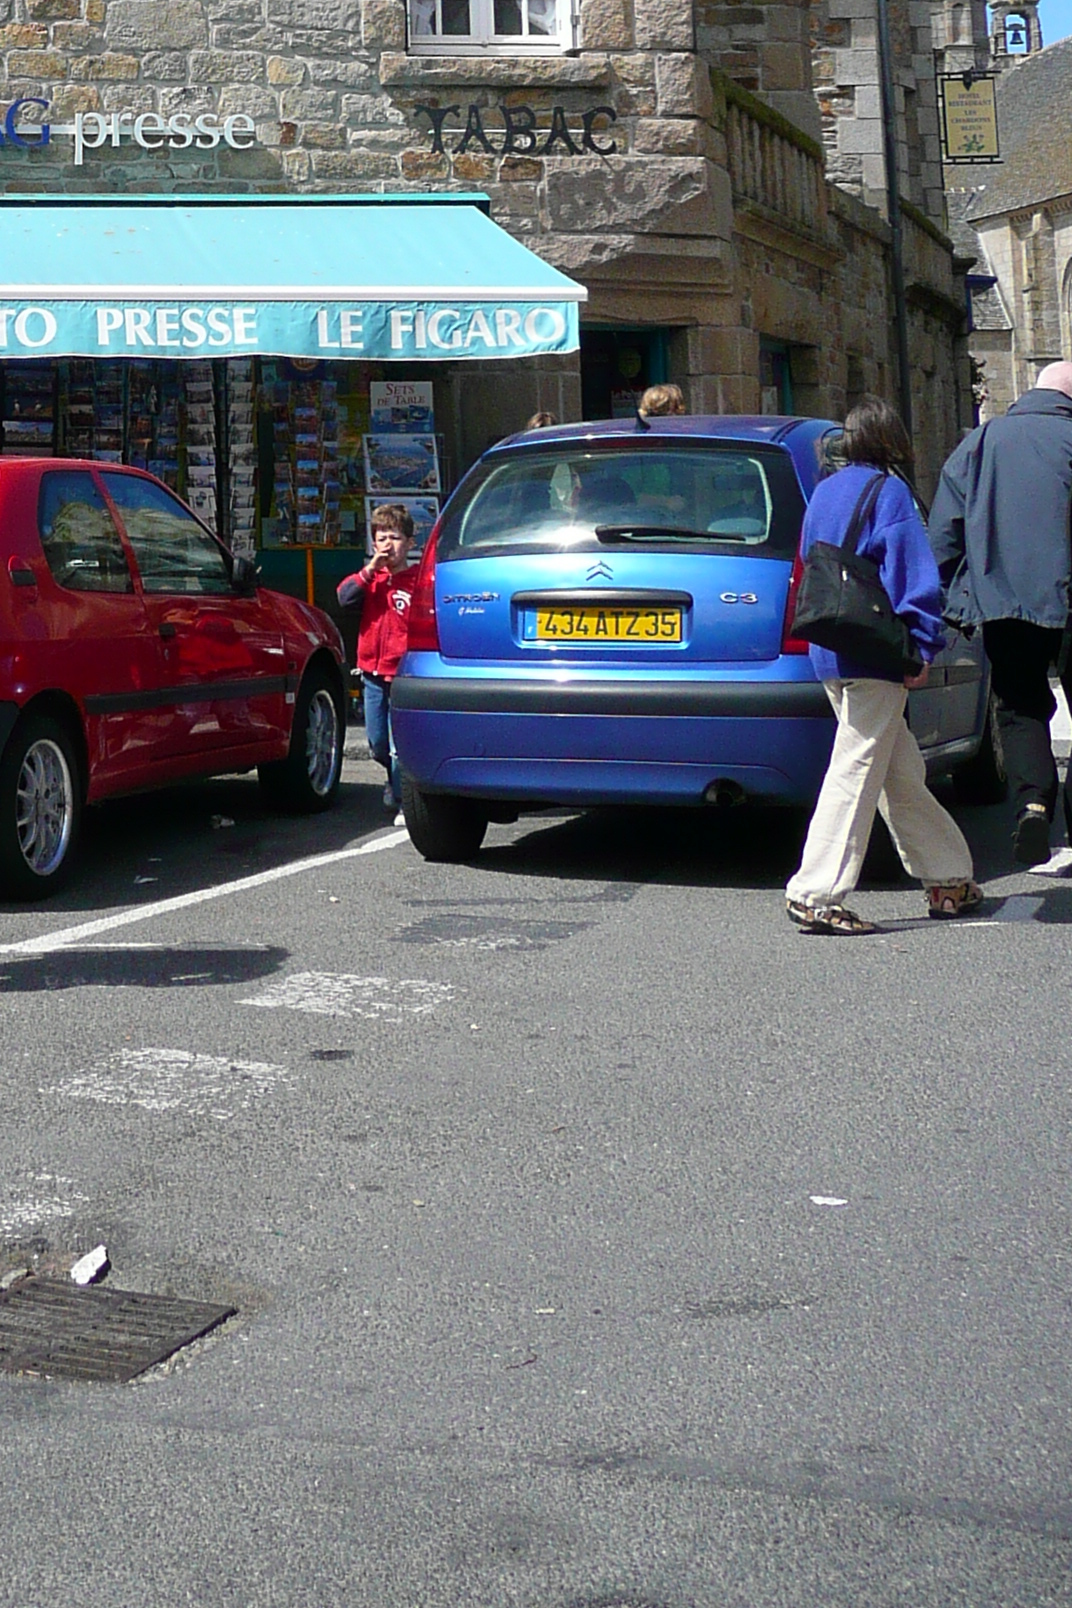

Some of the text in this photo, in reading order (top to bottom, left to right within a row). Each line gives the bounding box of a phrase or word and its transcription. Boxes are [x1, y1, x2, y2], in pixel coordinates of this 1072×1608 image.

[74, 110, 254, 165] presse
[413, 104, 617, 155] TABAC
[96, 307, 259, 347] PRESSE
[317, 309, 364, 349] LE
[390, 307, 565, 350] FIGARO
[719, 591, 758, 604] C3
